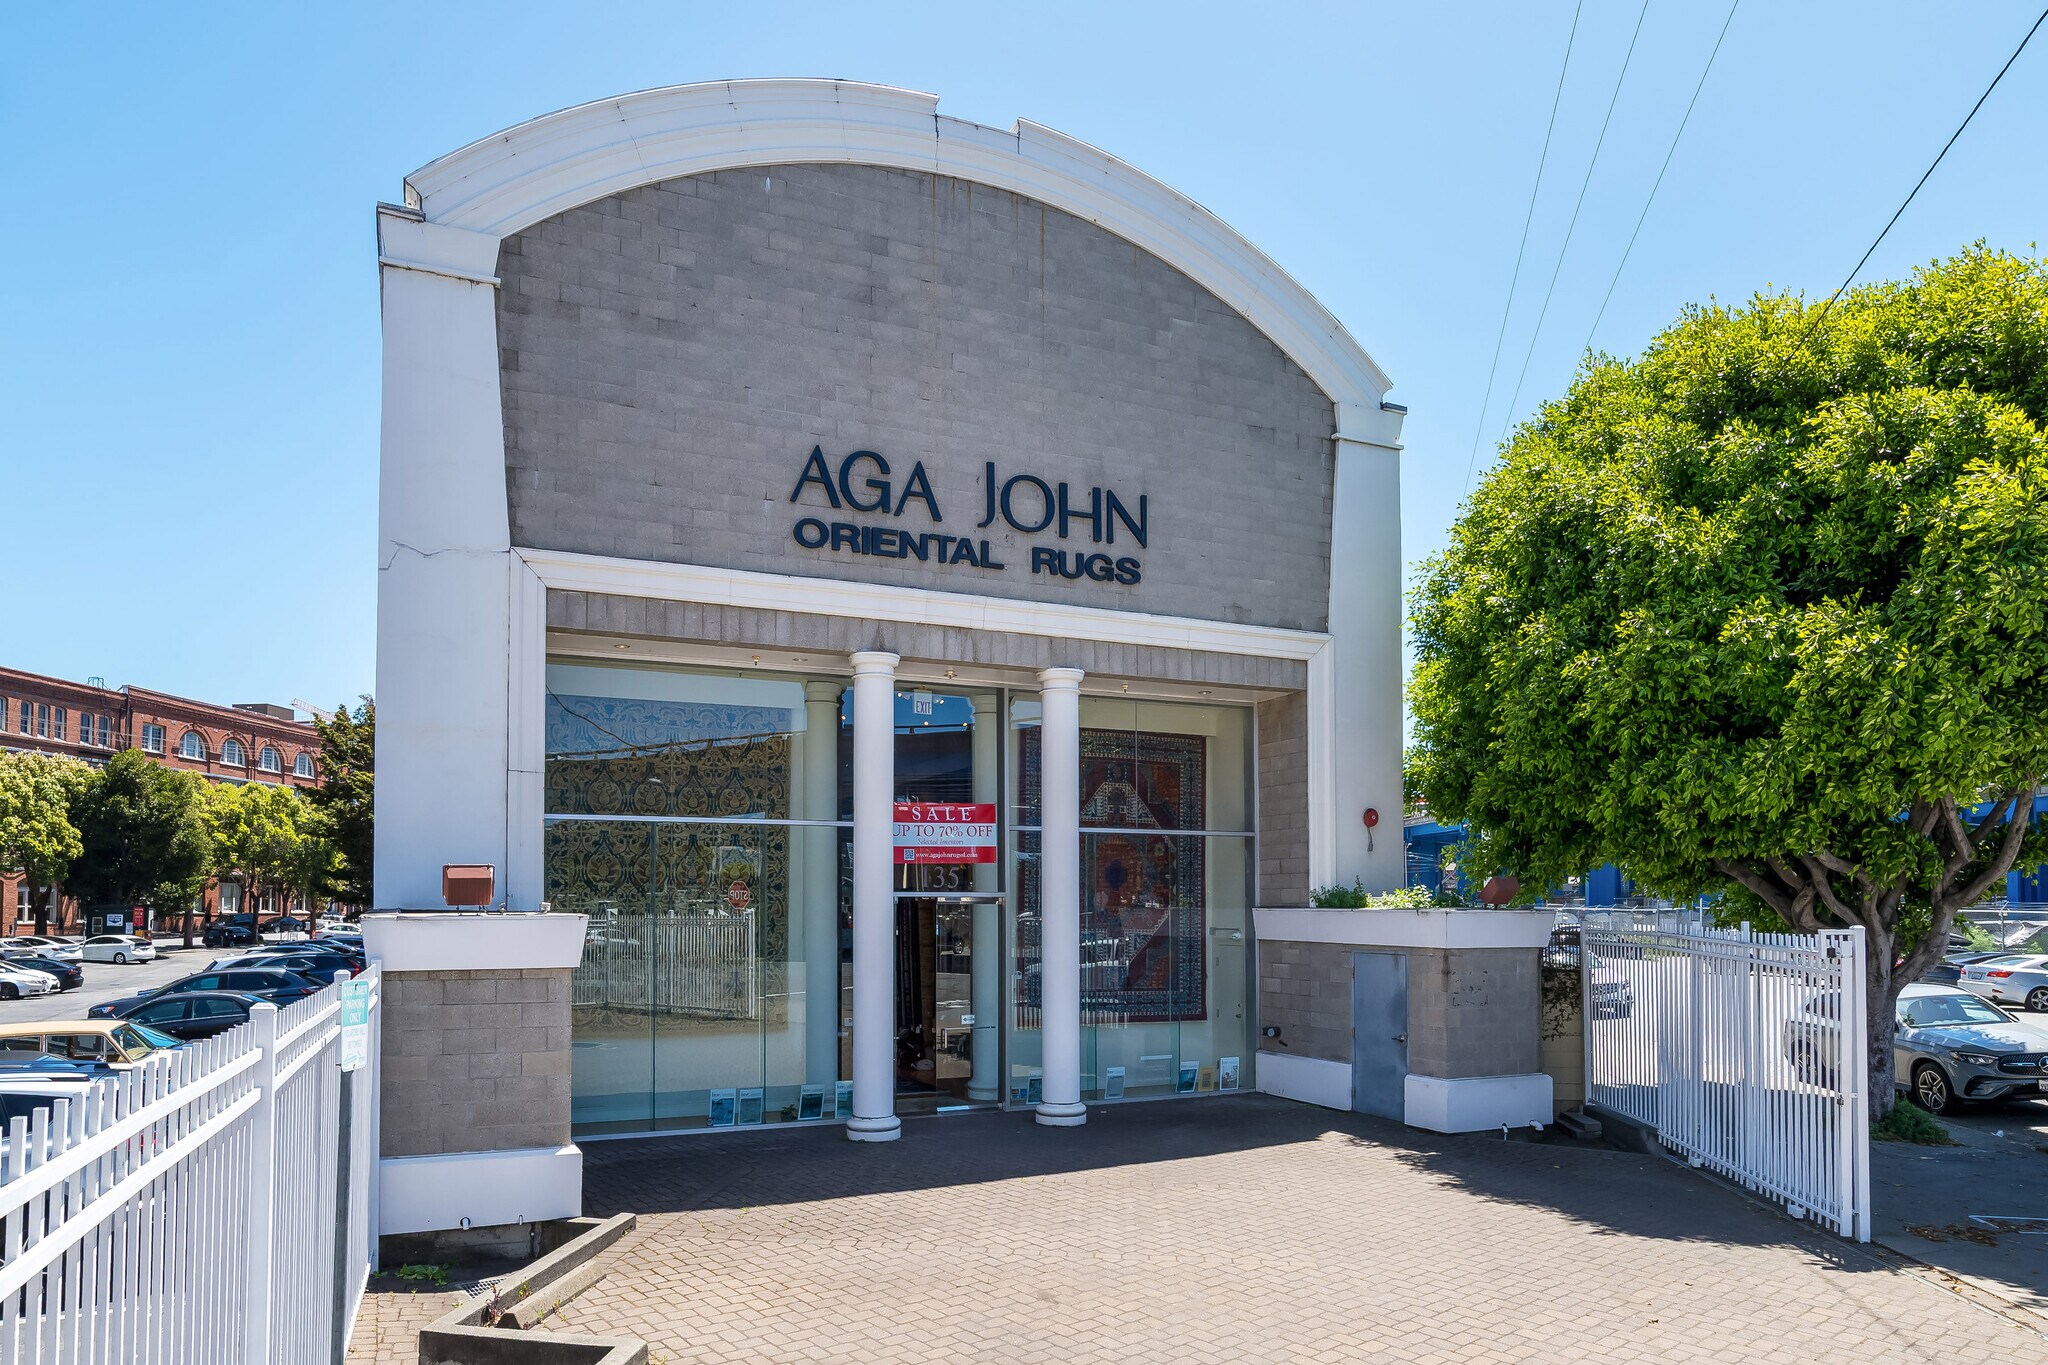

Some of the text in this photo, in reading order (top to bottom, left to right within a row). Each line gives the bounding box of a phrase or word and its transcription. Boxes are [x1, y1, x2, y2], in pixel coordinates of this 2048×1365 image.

[789, 444, 1148, 549] AGA JOHN
[793, 517, 1142, 585] ORIENTAL RUGS
[916, 700, 931, 713] EXIT
[912, 806, 971, 821] SALE
[893, 825, 993, 837] UP TO 70% OFF
[917, 838, 938, 846] Selected
[923, 865, 960, 889] 135
